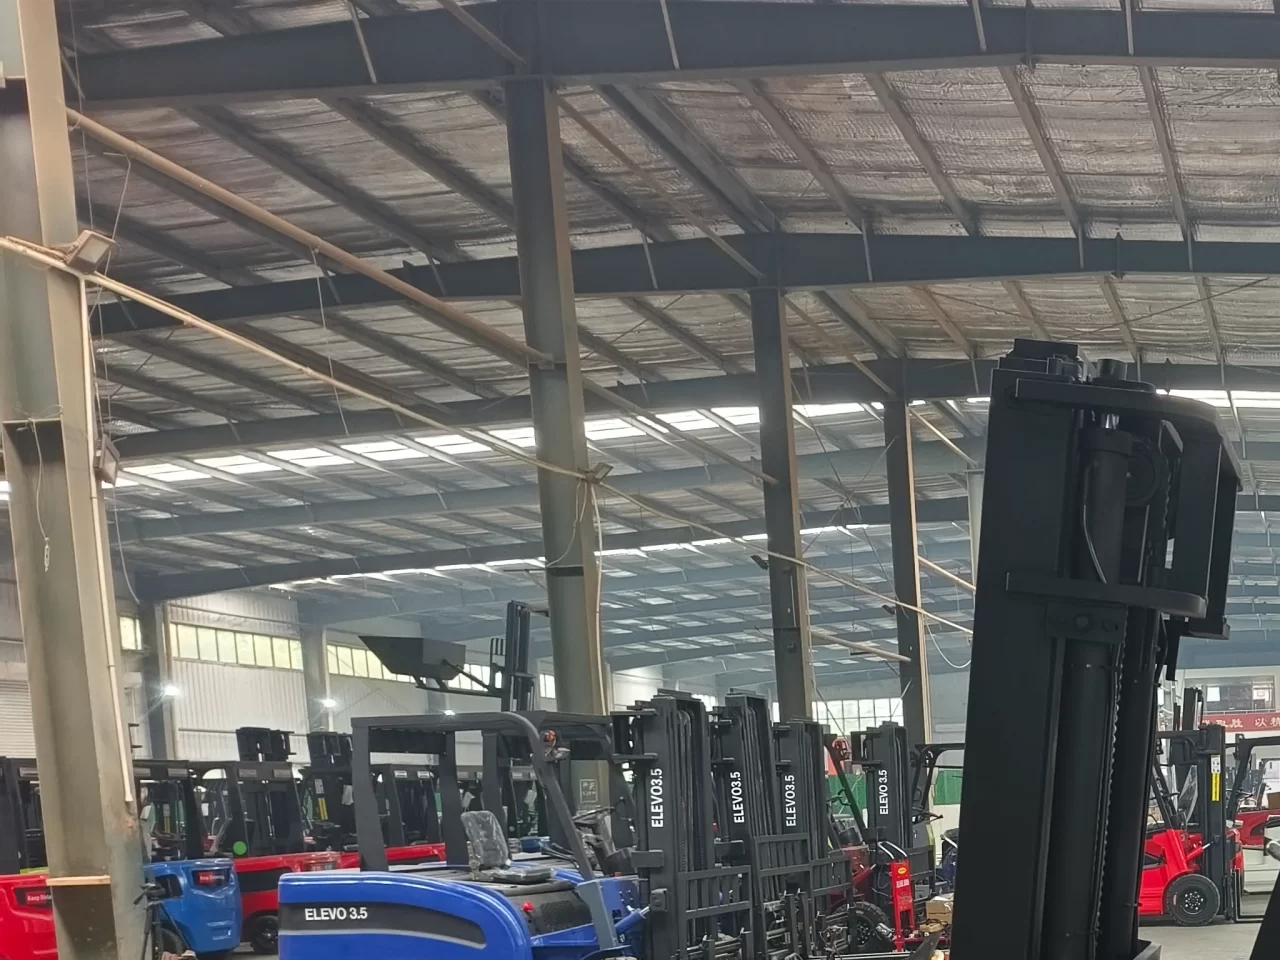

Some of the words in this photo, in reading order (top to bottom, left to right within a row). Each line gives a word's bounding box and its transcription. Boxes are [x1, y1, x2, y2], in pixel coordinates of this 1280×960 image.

[879, 769, 888, 783] 3.5
[650, 768, 664, 828] ELEVO3.5
[729, 771, 745, 823] ELEVO3.5
[879, 786, 889, 815] ELEVO
[305, 908, 347, 921] ELEVO
[349, 907, 368, 920] 3.5
